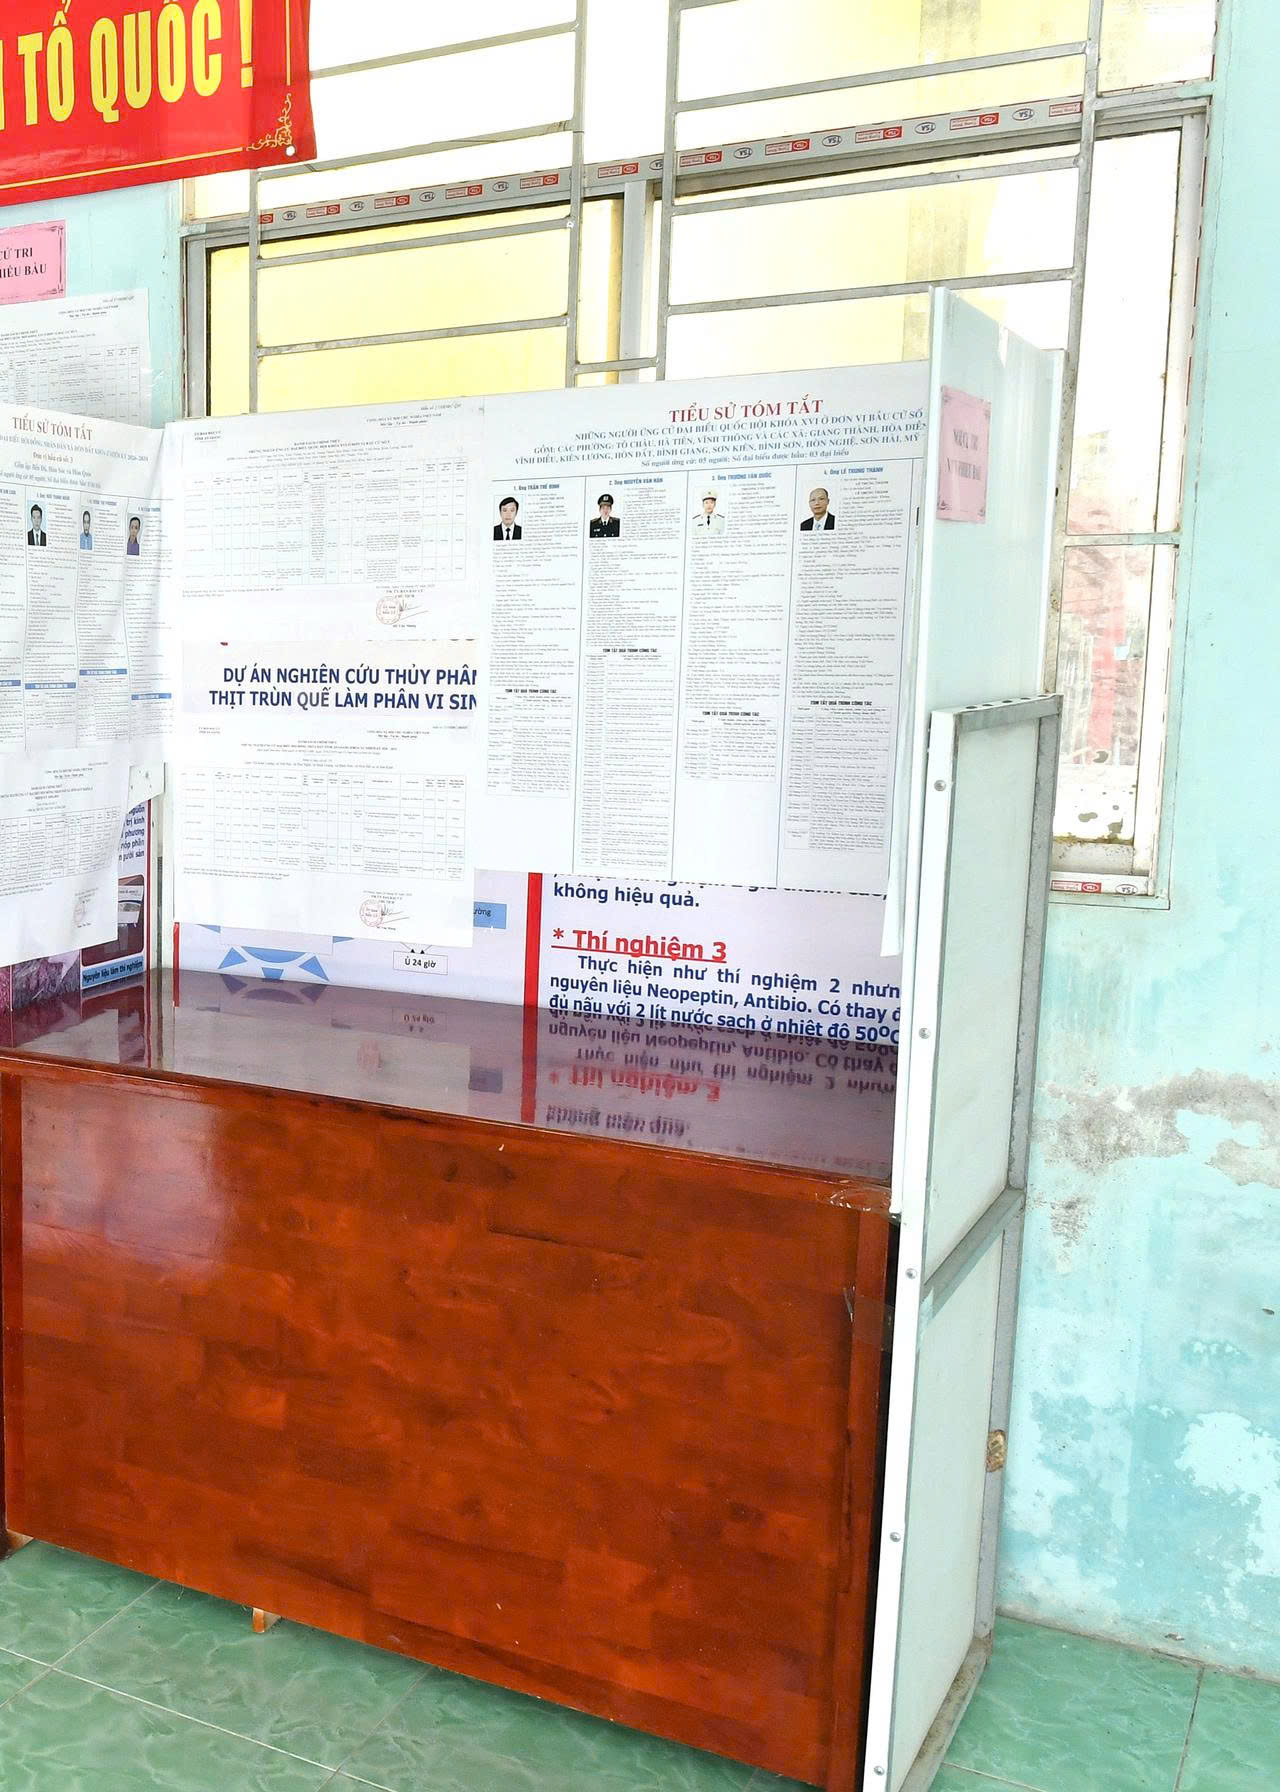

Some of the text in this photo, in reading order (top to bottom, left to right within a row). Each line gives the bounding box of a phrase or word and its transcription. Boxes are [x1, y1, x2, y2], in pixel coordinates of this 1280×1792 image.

[18, 0, 74, 125] TỔ
[90, 0, 222, 123] QUỐC
[15, 247, 33, 258] TRI
[24, 262, 47, 275] BẦU
[669, 394, 824, 424] TIỂU SỬ TÓM TẮT
[12, 412, 92, 440] TIỂU SỬ TÓM TẮT
[224, 666, 247, 686] DỰ
[250, 663, 271, 683] ÁN
[276, 664, 340, 684] NGHIÊN
[345, 663, 380, 685] CỨU
[385, 664, 431, 685] THỦY
[209, 691, 245, 709] THỊT
[250, 686, 292, 707] TRÙN
[297, 687, 331, 710] QUẾ
[334, 687, 368, 708] LÀM
[374, 688, 420, 710] PHÂN
[425, 694, 444, 710] VI
[554, 882, 700, 908] không hiệu quả.
[572, 930, 608, 950] Thí
[616, 935, 703, 961] nghiệm
[712, 941, 726, 961] 3
[404, 956, 436, 968] Ủ 24 giờ
[578, 956, 618, 974] Thực
[628, 959, 662, 979] hiện
[674, 964, 708, 980] như
[718, 968, 740, 984] thí
[751, 972, 817, 994] nghiệm
[829, 978, 840, 993] 2
[549, 994, 568, 1010] đủ
[574, 996, 602, 1013] nấu
[607, 1002, 630, 1016] với
[636, 1004, 645, 1018] 2
[650, 1003, 666, 1020] lít
[672, 1008, 713, 1025] nước
[761, 1016, 772, 1031] ở
[550, 976, 608, 994] nguyên
[614, 979, 642, 998] liệu
[648, 983, 738, 1008] Neopeptin,
[744, 992, 812, 1013] Antibio.
[818, 1000, 840, 1015] Có
[846, 1002, 887, 1024] thay
